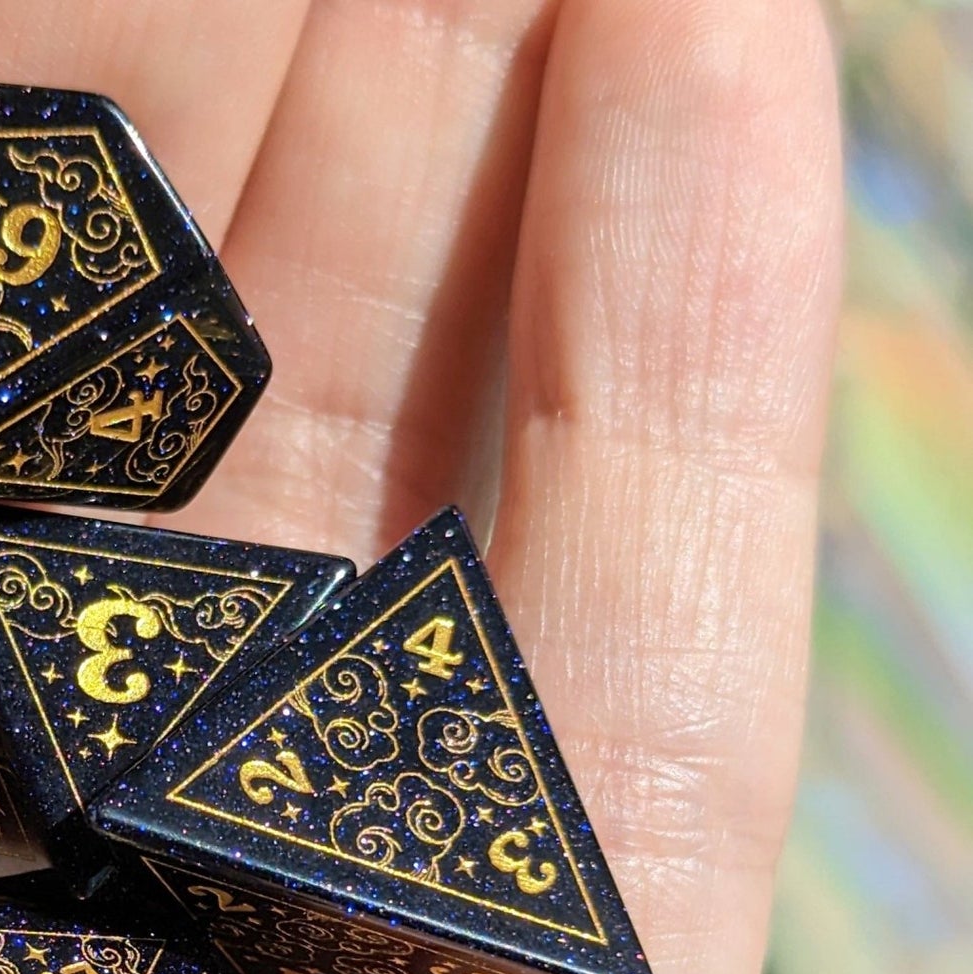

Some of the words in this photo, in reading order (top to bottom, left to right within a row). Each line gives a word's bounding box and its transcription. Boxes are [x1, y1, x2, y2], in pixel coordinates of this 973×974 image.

[90, 389, 164, 443] 4
[77, 598, 161, 704] 3
[403, 616, 465, 681] 4
[238, 750, 315, 806] 2
[488, 830, 557, 894] 3
